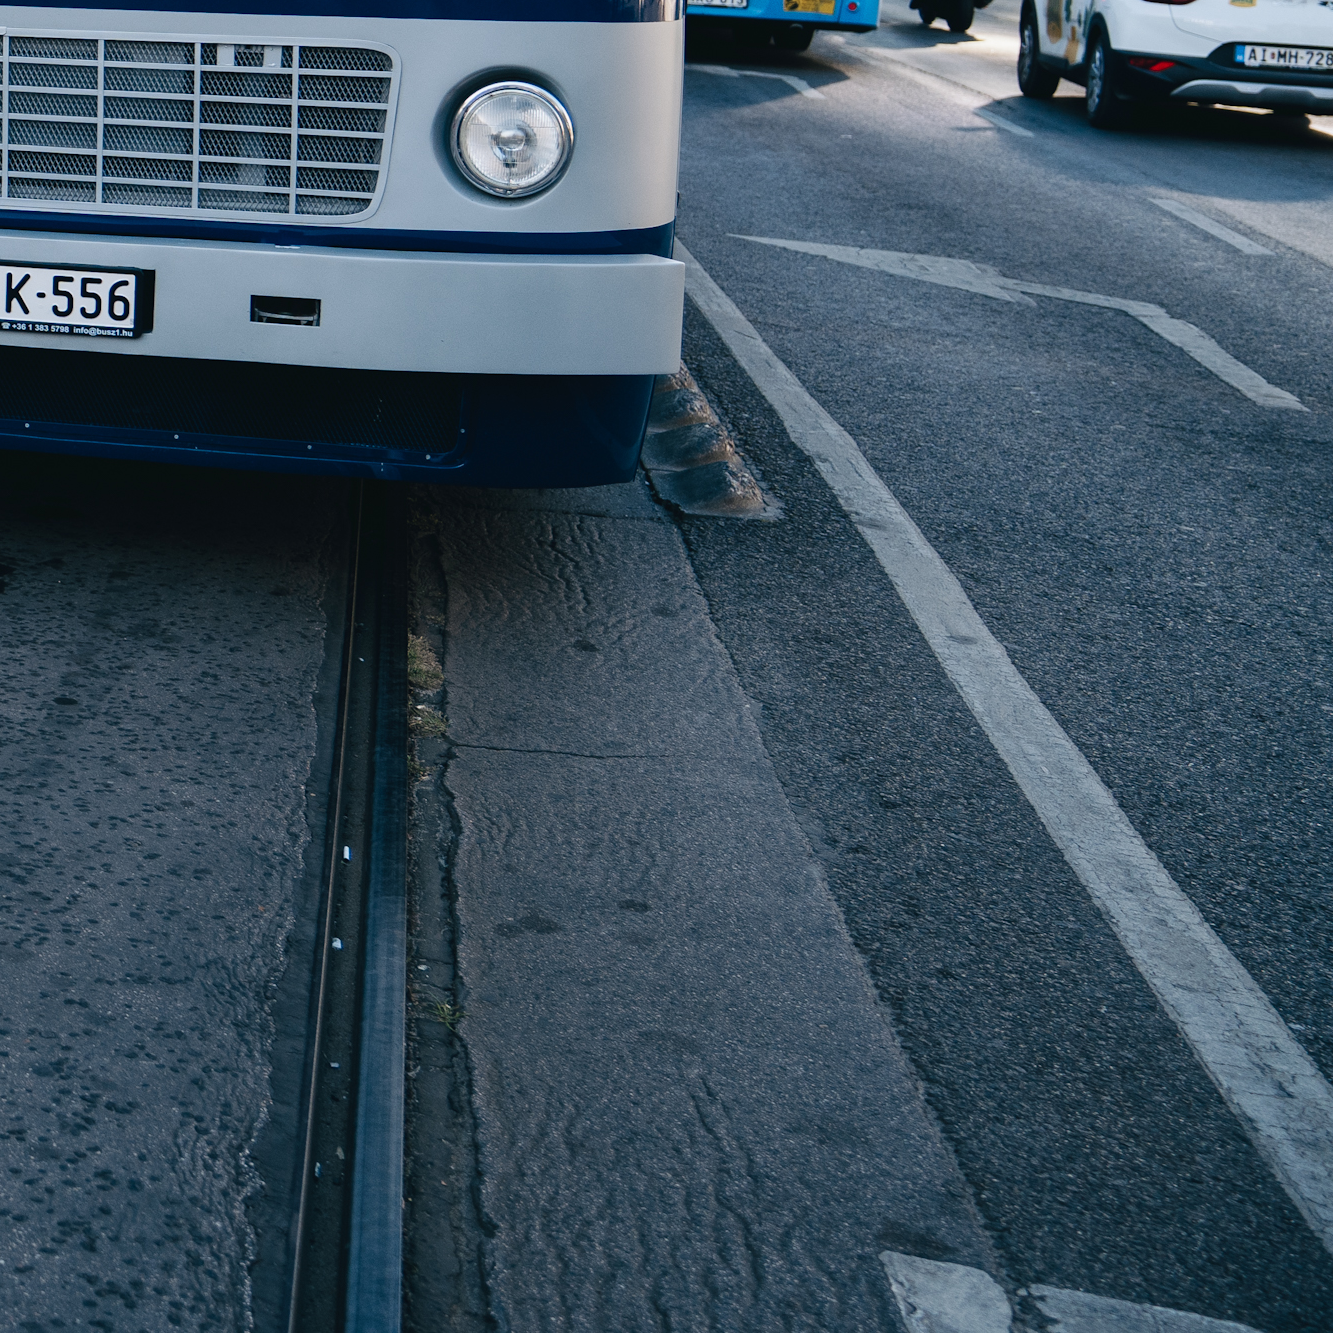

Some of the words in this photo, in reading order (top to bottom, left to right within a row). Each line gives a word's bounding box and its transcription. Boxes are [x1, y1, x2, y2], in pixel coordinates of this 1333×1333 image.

[1248, 48, 1267, 62] AI
[1277, 49, 1333, 66] MH-728
[11, 322, 27, 331] +36
[34, 324, 49, 332] 383
[50, 324, 70, 333] 5798
